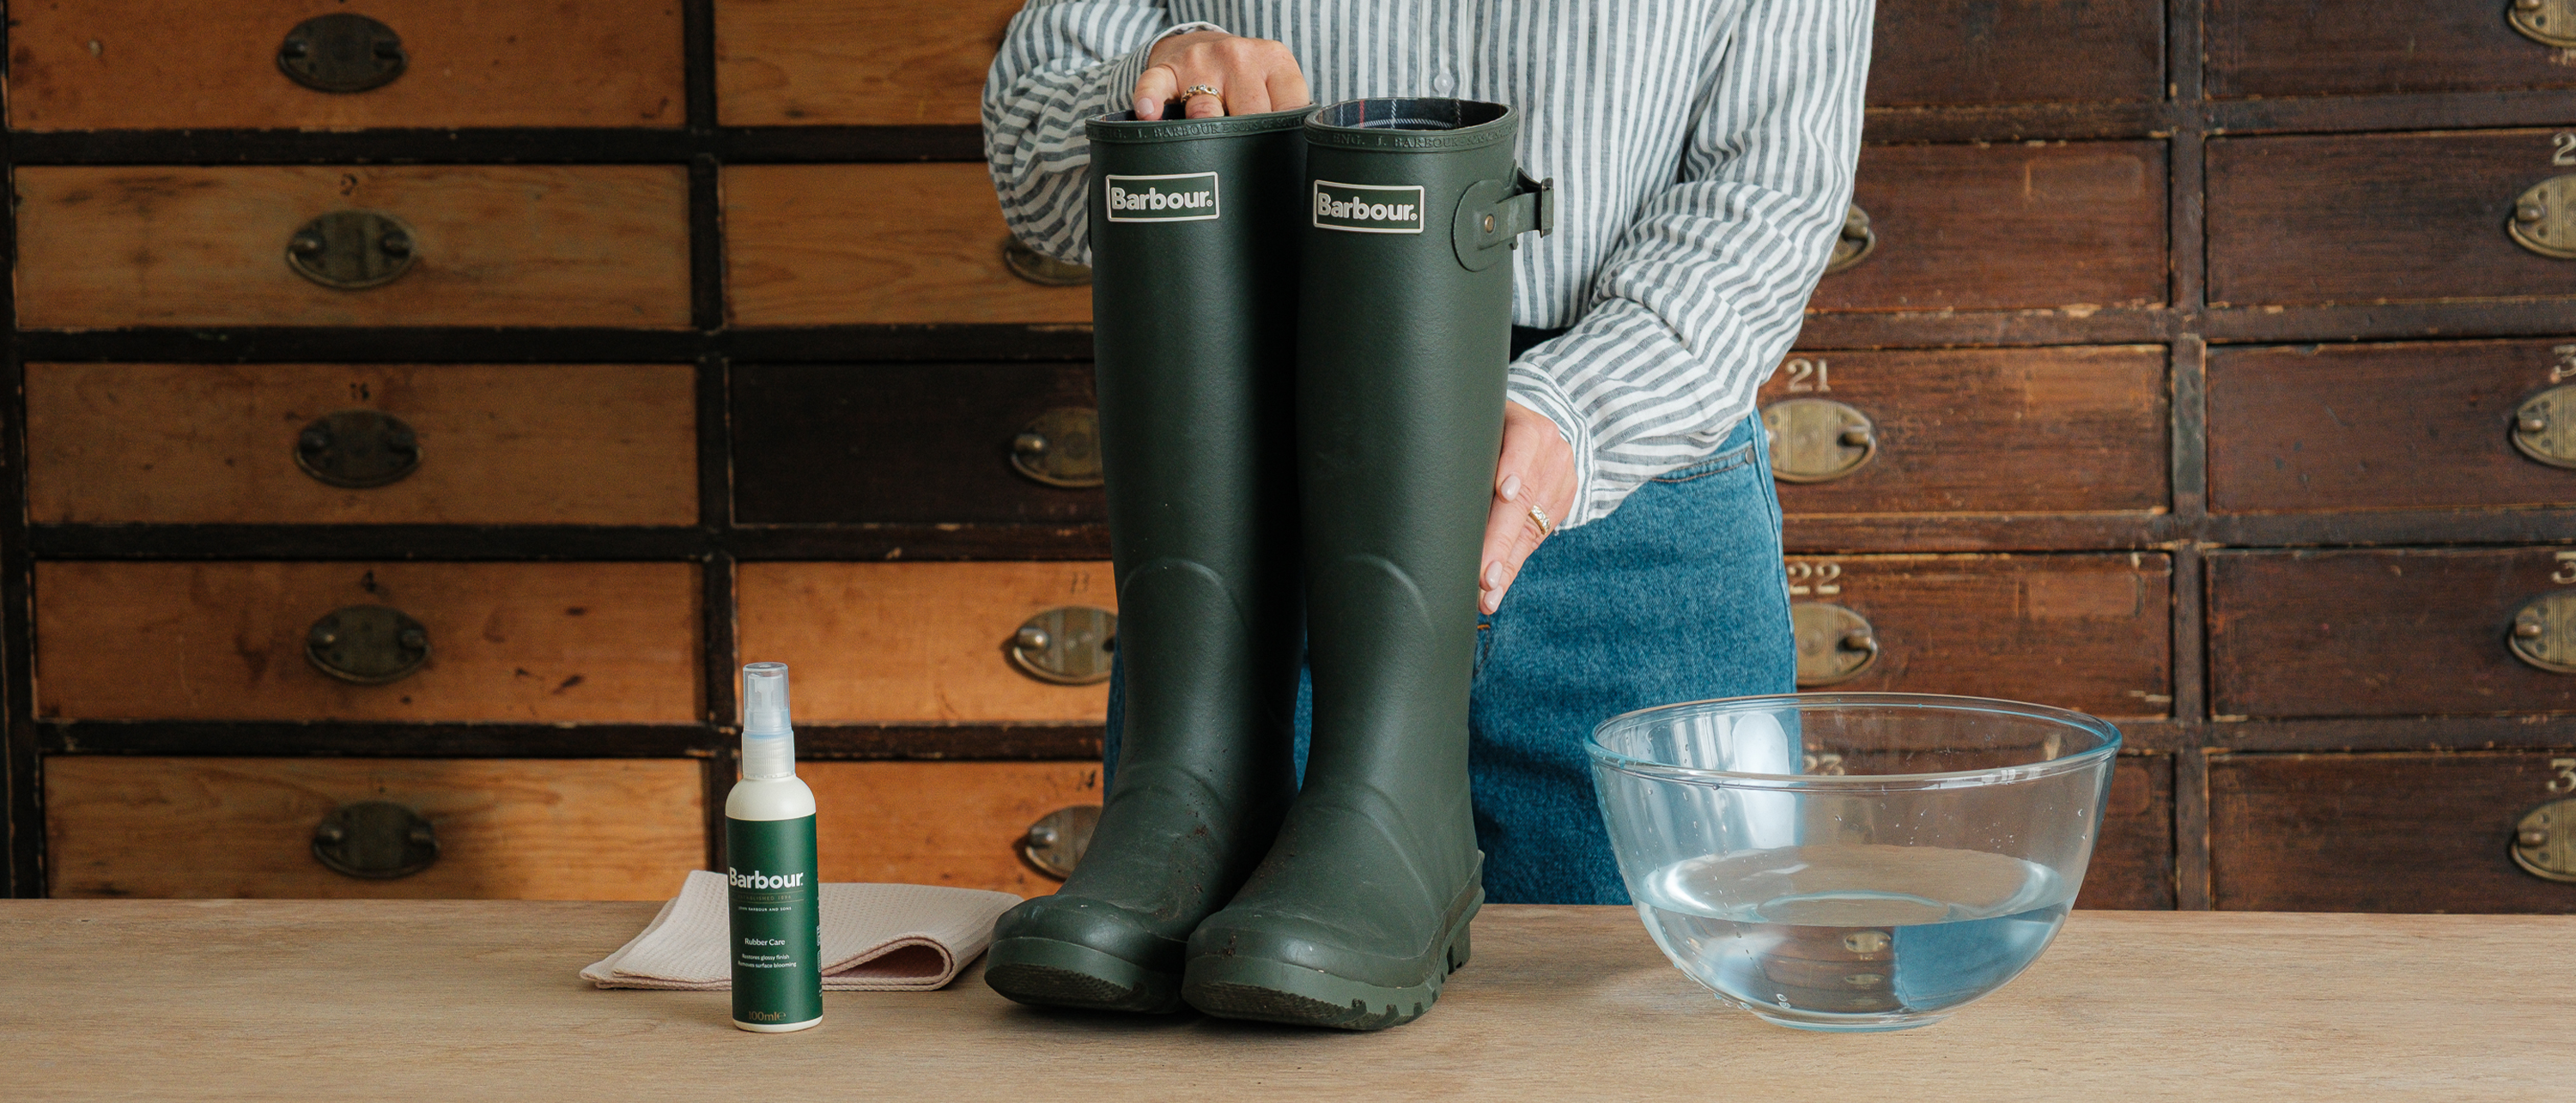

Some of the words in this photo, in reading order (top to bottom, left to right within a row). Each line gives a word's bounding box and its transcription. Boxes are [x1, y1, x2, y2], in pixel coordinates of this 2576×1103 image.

[1153, 123, 1218, 138] BARBOUR
[1787, 358, 1831, 392] 21
[1787, 560, 1840, 595] 22
[744, 937, 768, 946] Rubber
